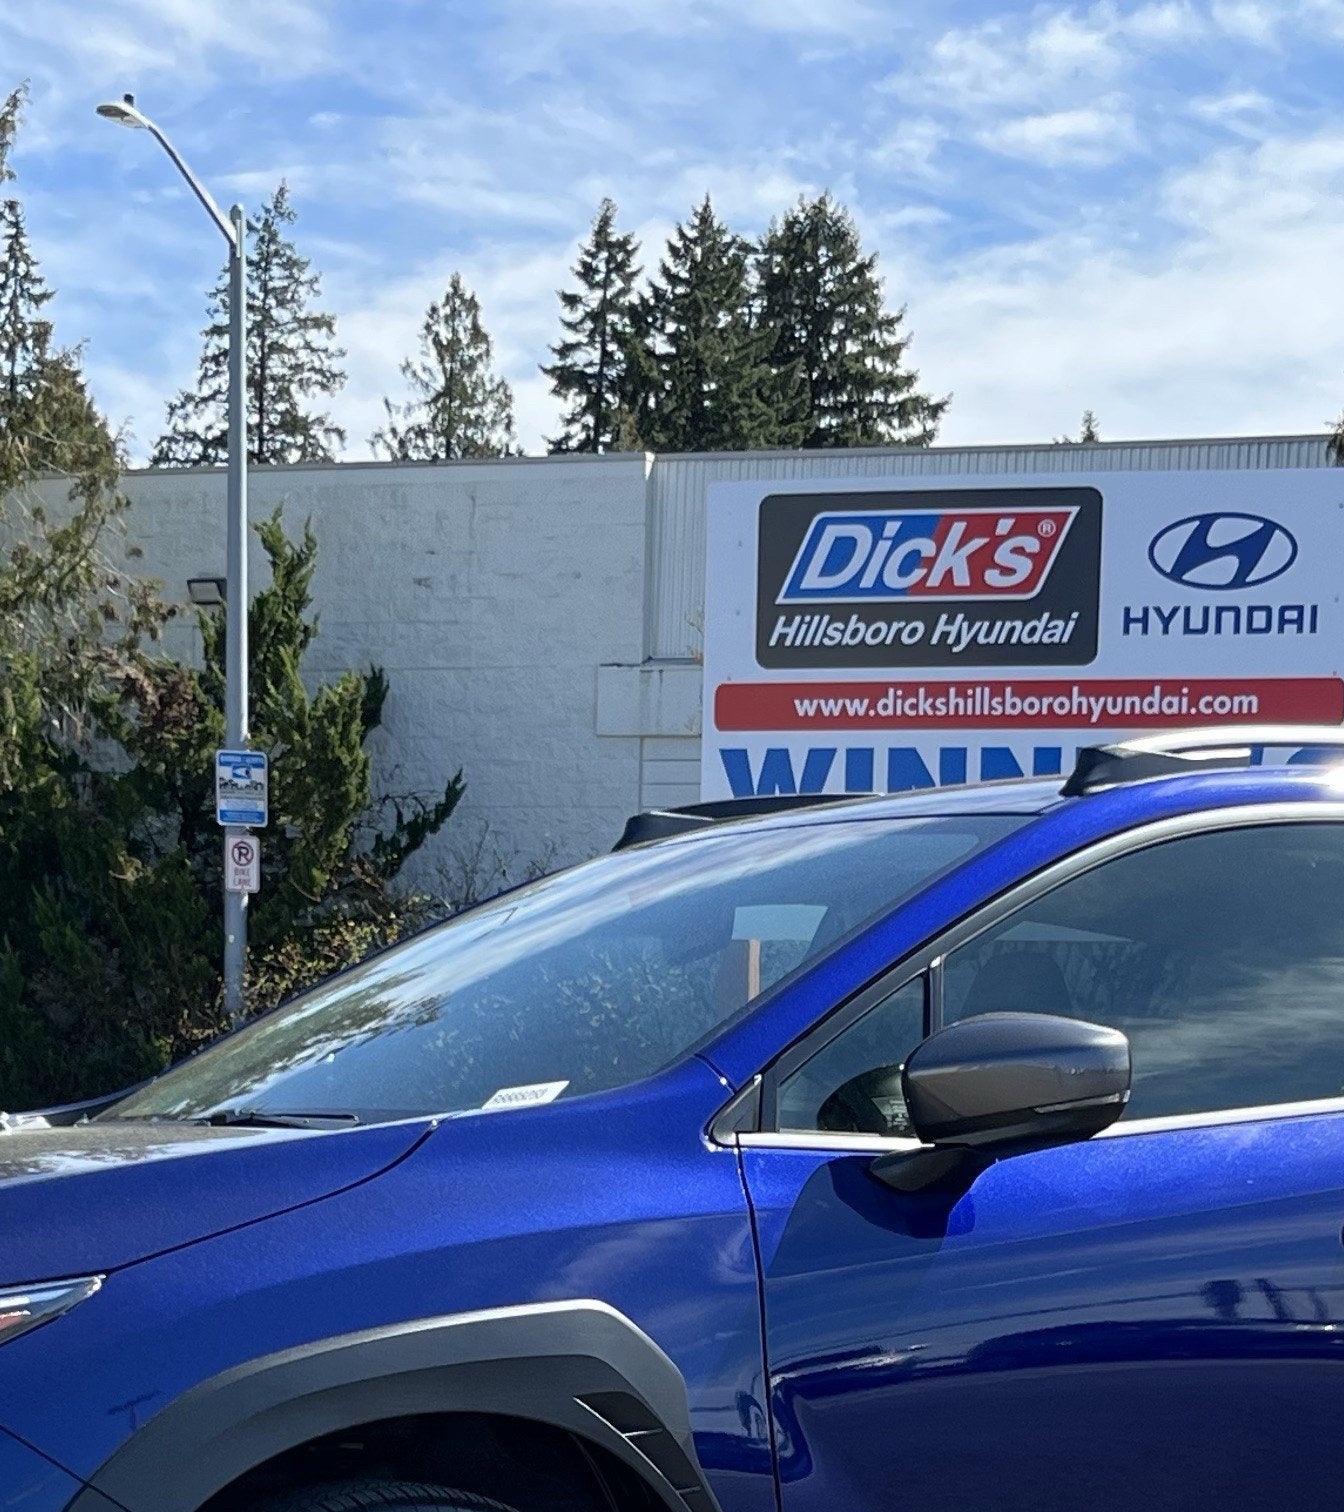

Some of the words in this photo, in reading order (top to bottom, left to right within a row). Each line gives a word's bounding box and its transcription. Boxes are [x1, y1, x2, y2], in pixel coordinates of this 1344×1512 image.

[799, 519, 1042, 590] Dick's
[768, 614, 922, 647] Hillsboro
[929, 611, 1079, 653] Hyundai
[1123, 604, 1319, 636] HYUNDAI
[792, 688, 1259, 725] www.dickshillsborohyundai.com
